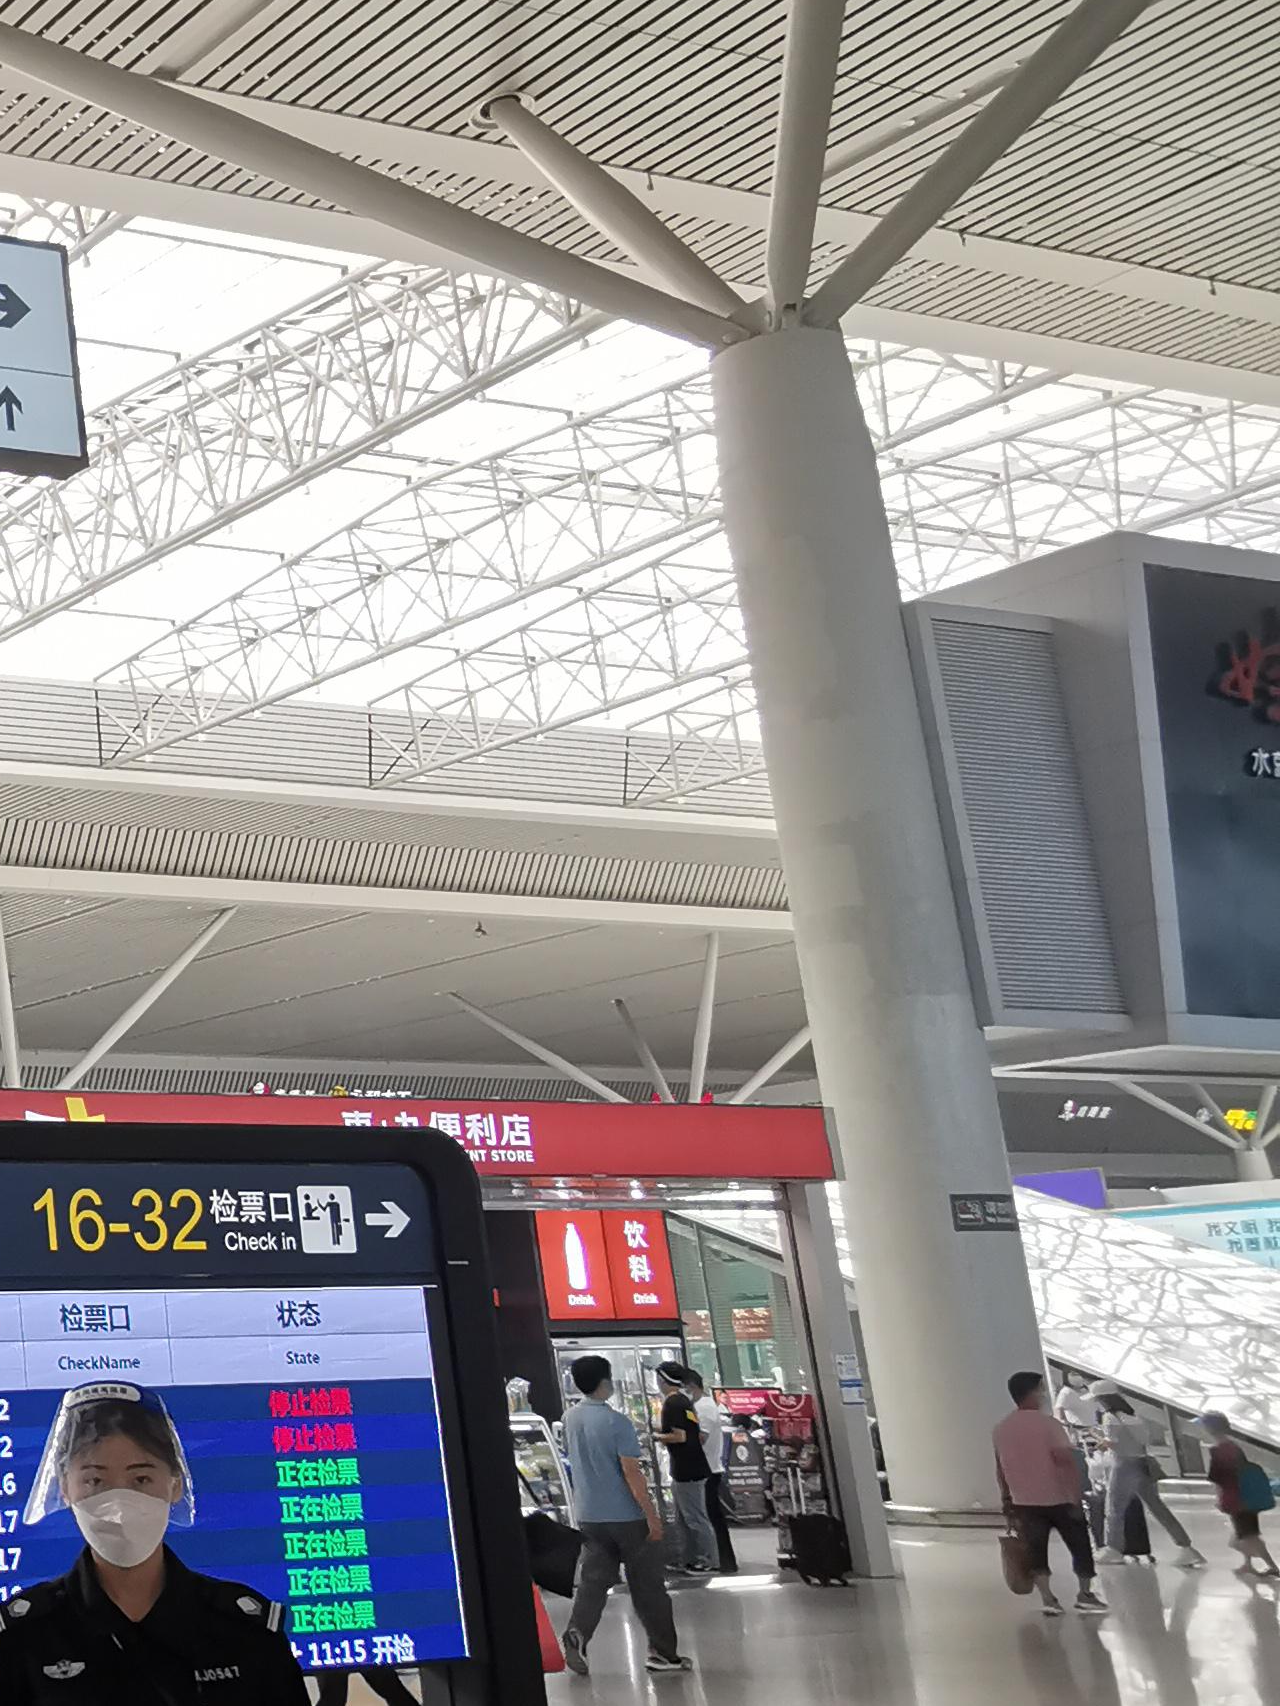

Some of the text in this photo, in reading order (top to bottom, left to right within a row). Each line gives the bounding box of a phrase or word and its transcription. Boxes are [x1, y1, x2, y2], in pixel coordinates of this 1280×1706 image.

[464, 1149, 535, 1163] NT STORE
[33, 1187, 294, 1253] 16-32 检票口
[225, 1232, 297, 1252] Check in
[624, 1220, 652, 1283] 饮料
[277, 1300, 321, 1329] 状态
[568, 1294, 595, 1306] Drink
[633, 1293, 659, 1305] Drink
[59, 1303, 130, 1333] 检票口
[58, 1354, 140, 1371] CheckName
[286, 1351, 320, 1366] State
[269, 1387, 354, 1419] 停止检票
[272, 1423, 358, 1454] 停止检票
[275, 1458, 360, 1489] 正在检票
[279, 1493, 365, 1525] 正在检票
[283, 1528, 369, 1560] 正在检票
[287, 1564, 373, 1597] 正在检票
[291, 1600, 376, 1634] 正在检票
[308, 1639, 367, 1666] 11:15
[372, 1633, 417, 1665] 开检
